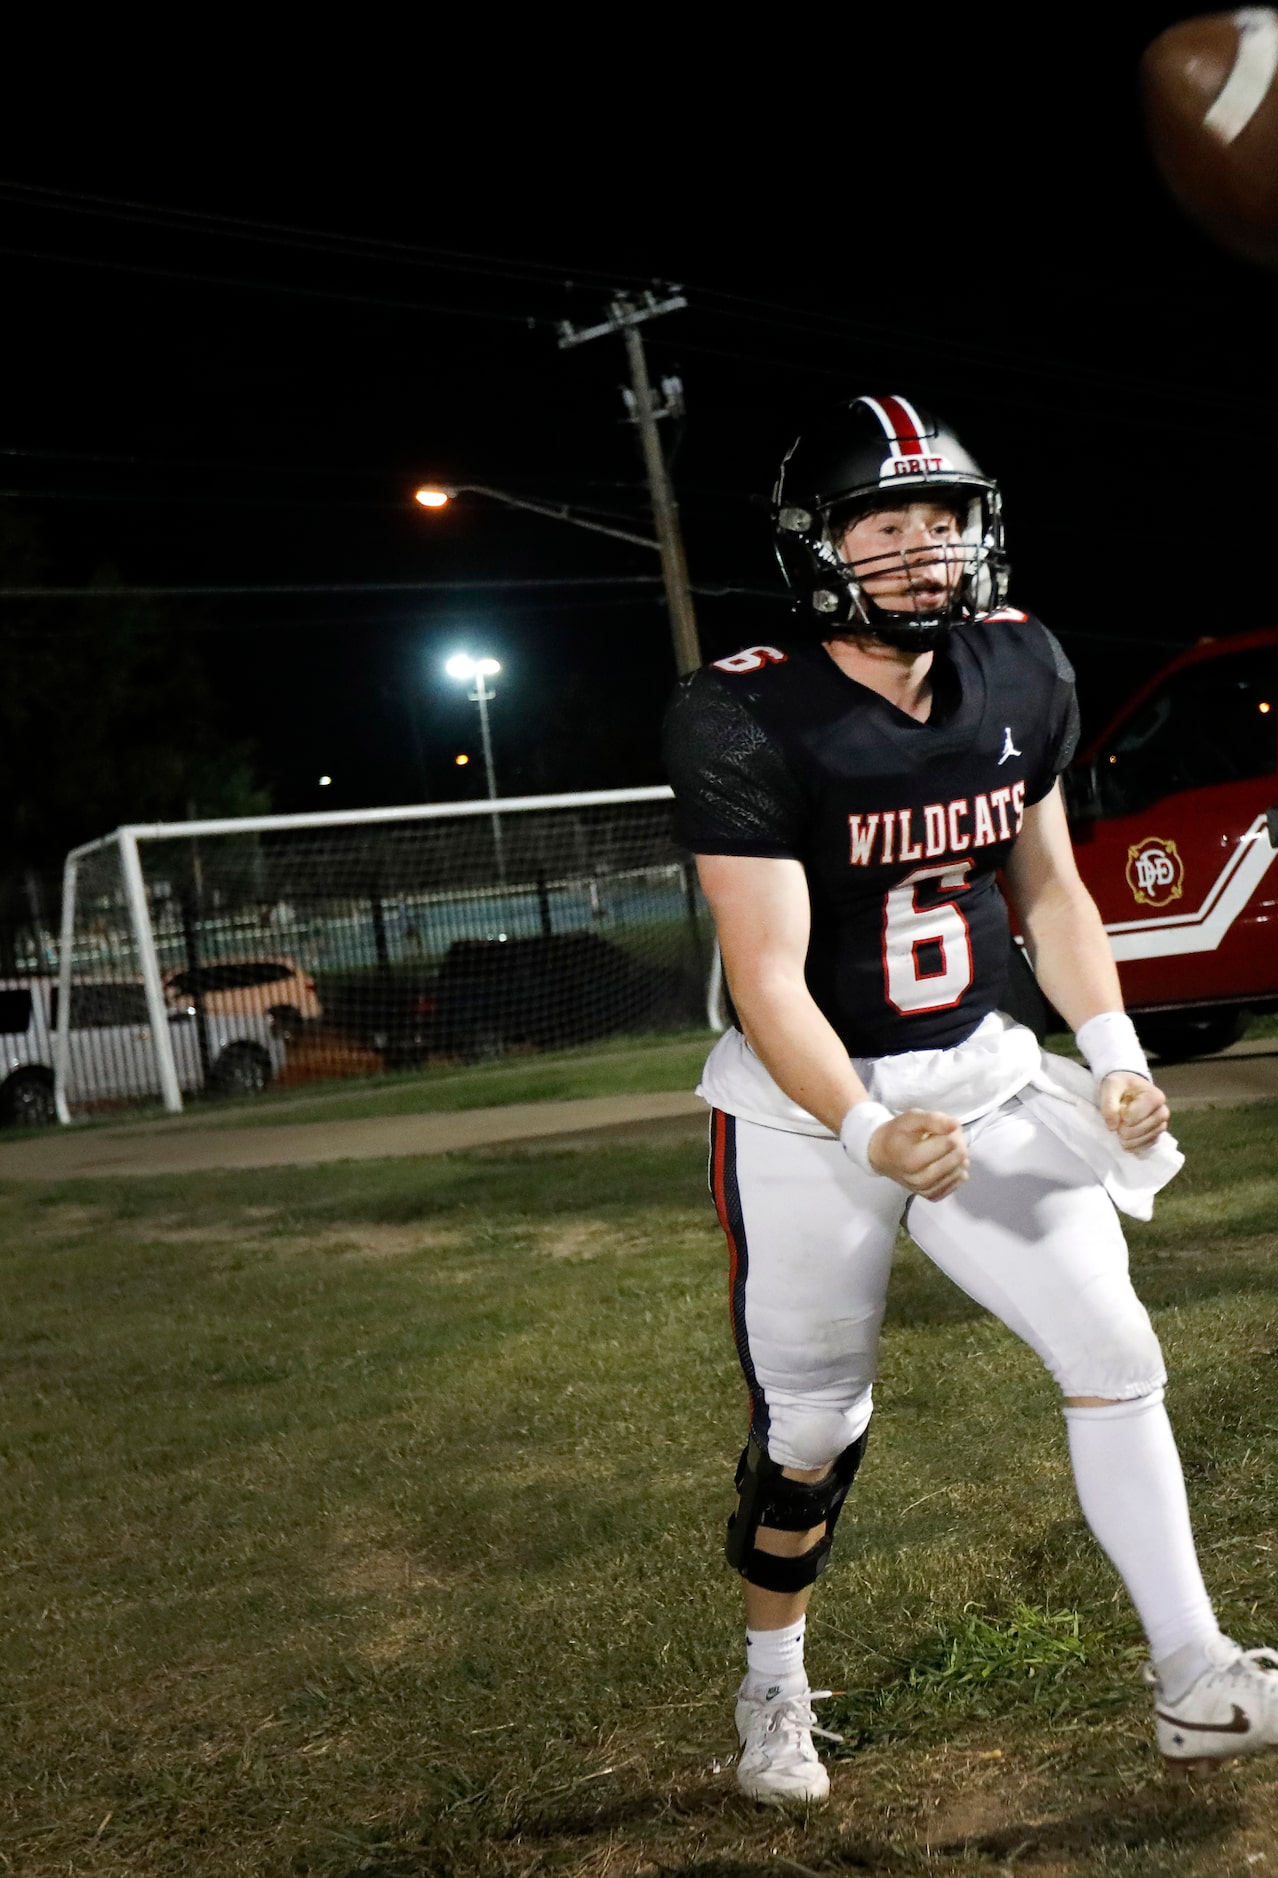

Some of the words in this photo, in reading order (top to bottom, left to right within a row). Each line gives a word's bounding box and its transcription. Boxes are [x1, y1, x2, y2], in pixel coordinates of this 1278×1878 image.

[894, 457, 943, 475] GRIT
[848, 780, 1026, 867] WILDCATS
[881, 857, 977, 1017] 6
